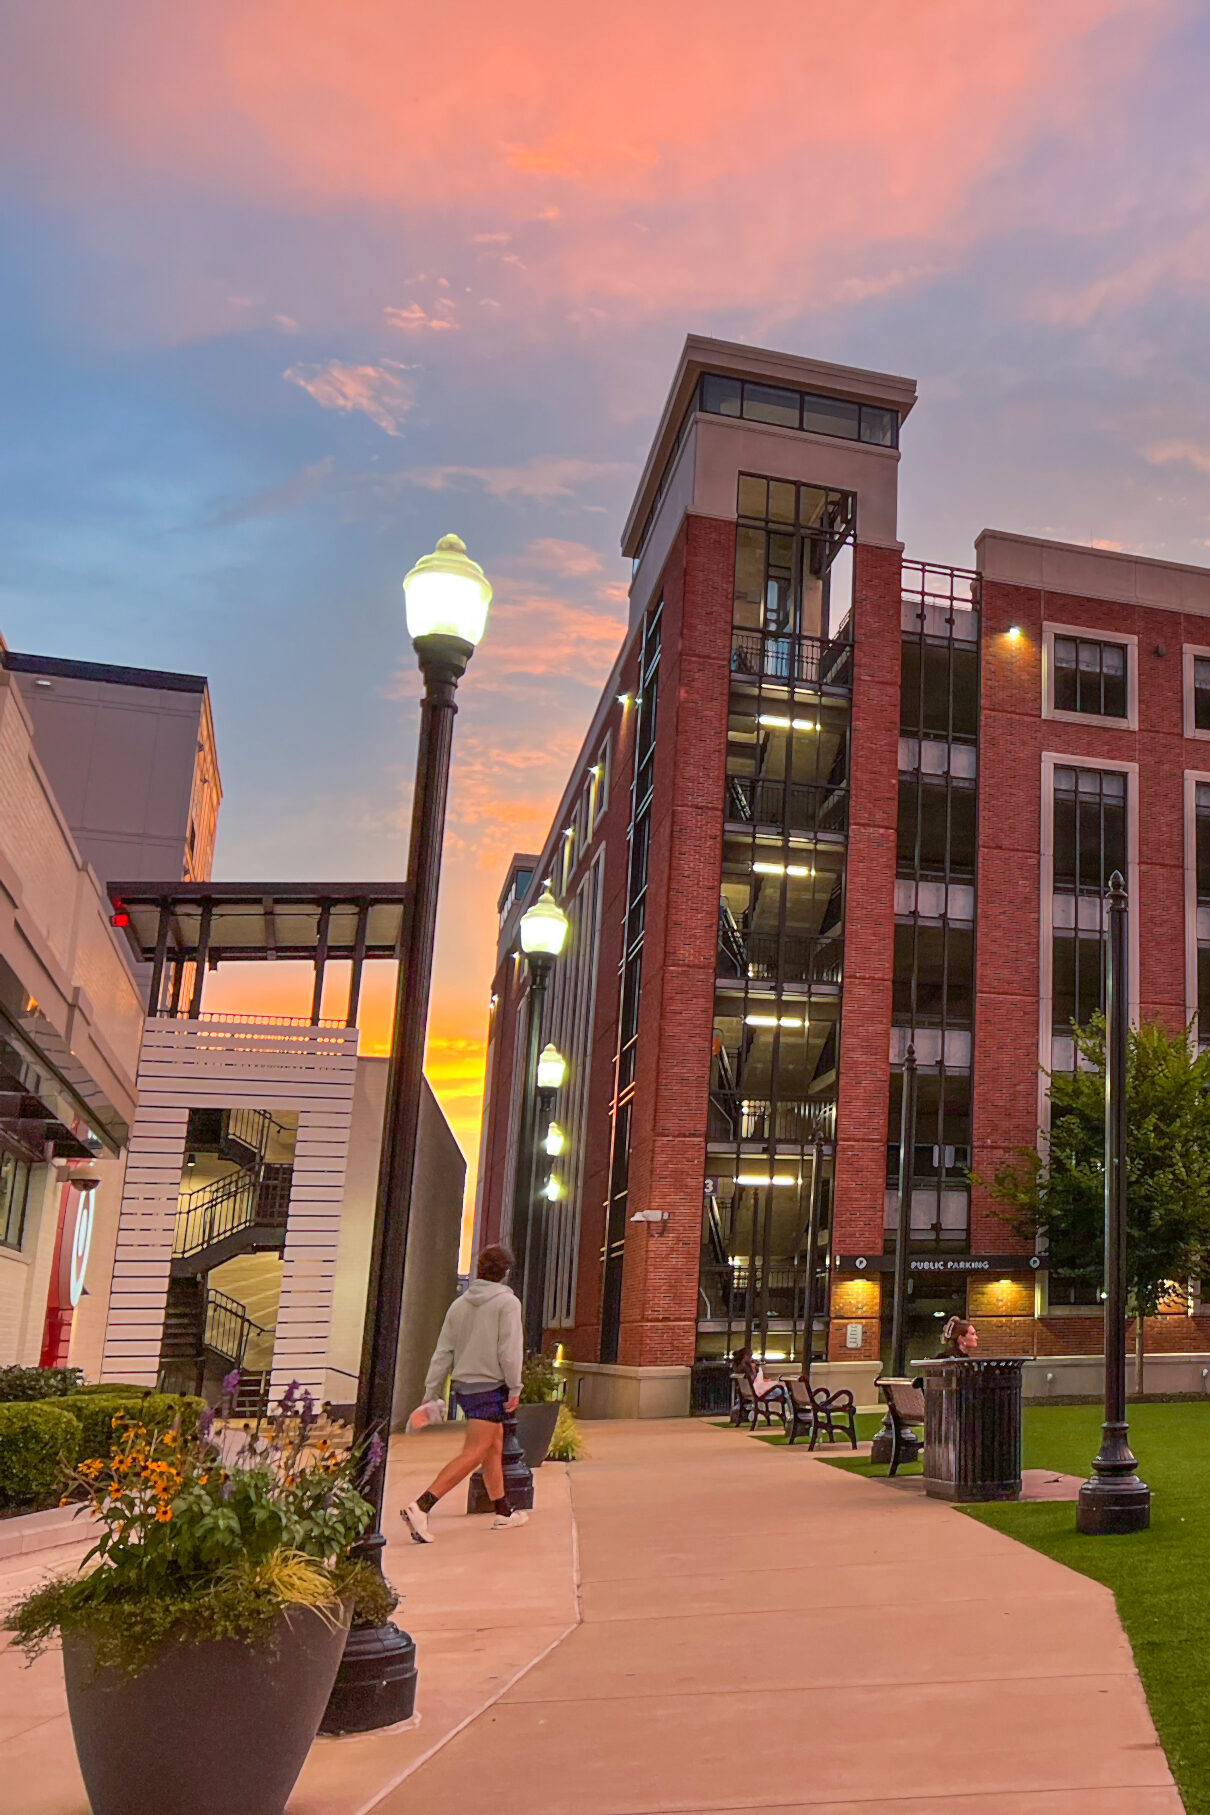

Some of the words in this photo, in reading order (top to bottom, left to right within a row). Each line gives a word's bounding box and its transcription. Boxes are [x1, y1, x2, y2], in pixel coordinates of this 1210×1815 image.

[704, 1178, 714, 1193] 3
[910, 1261, 945, 1270] PUBLIC
[947, 1261, 990, 1270] PARKING
